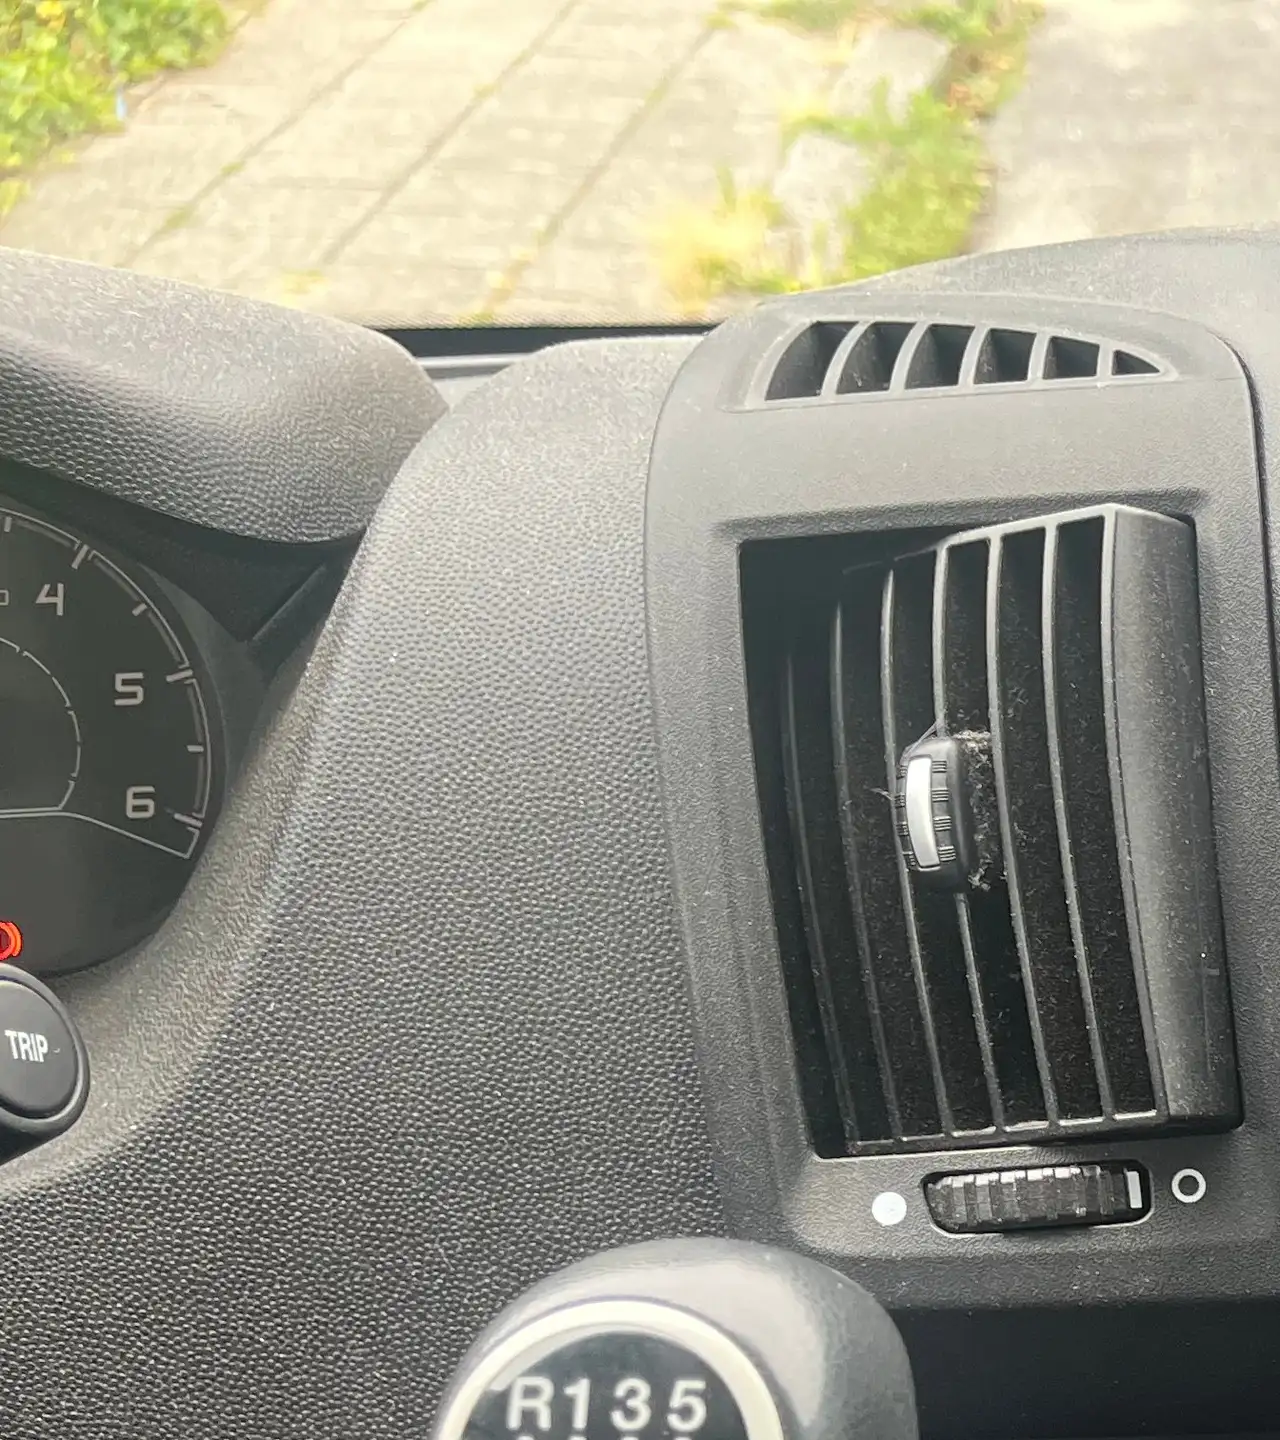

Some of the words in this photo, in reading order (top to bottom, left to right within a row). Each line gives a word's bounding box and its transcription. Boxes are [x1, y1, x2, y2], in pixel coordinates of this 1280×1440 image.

[36, 583, 64, 616] 4
[114, 672, 144, 706] 5
[126, 786, 155, 819] 6
[4, 1029, 49, 1063] TRIP
